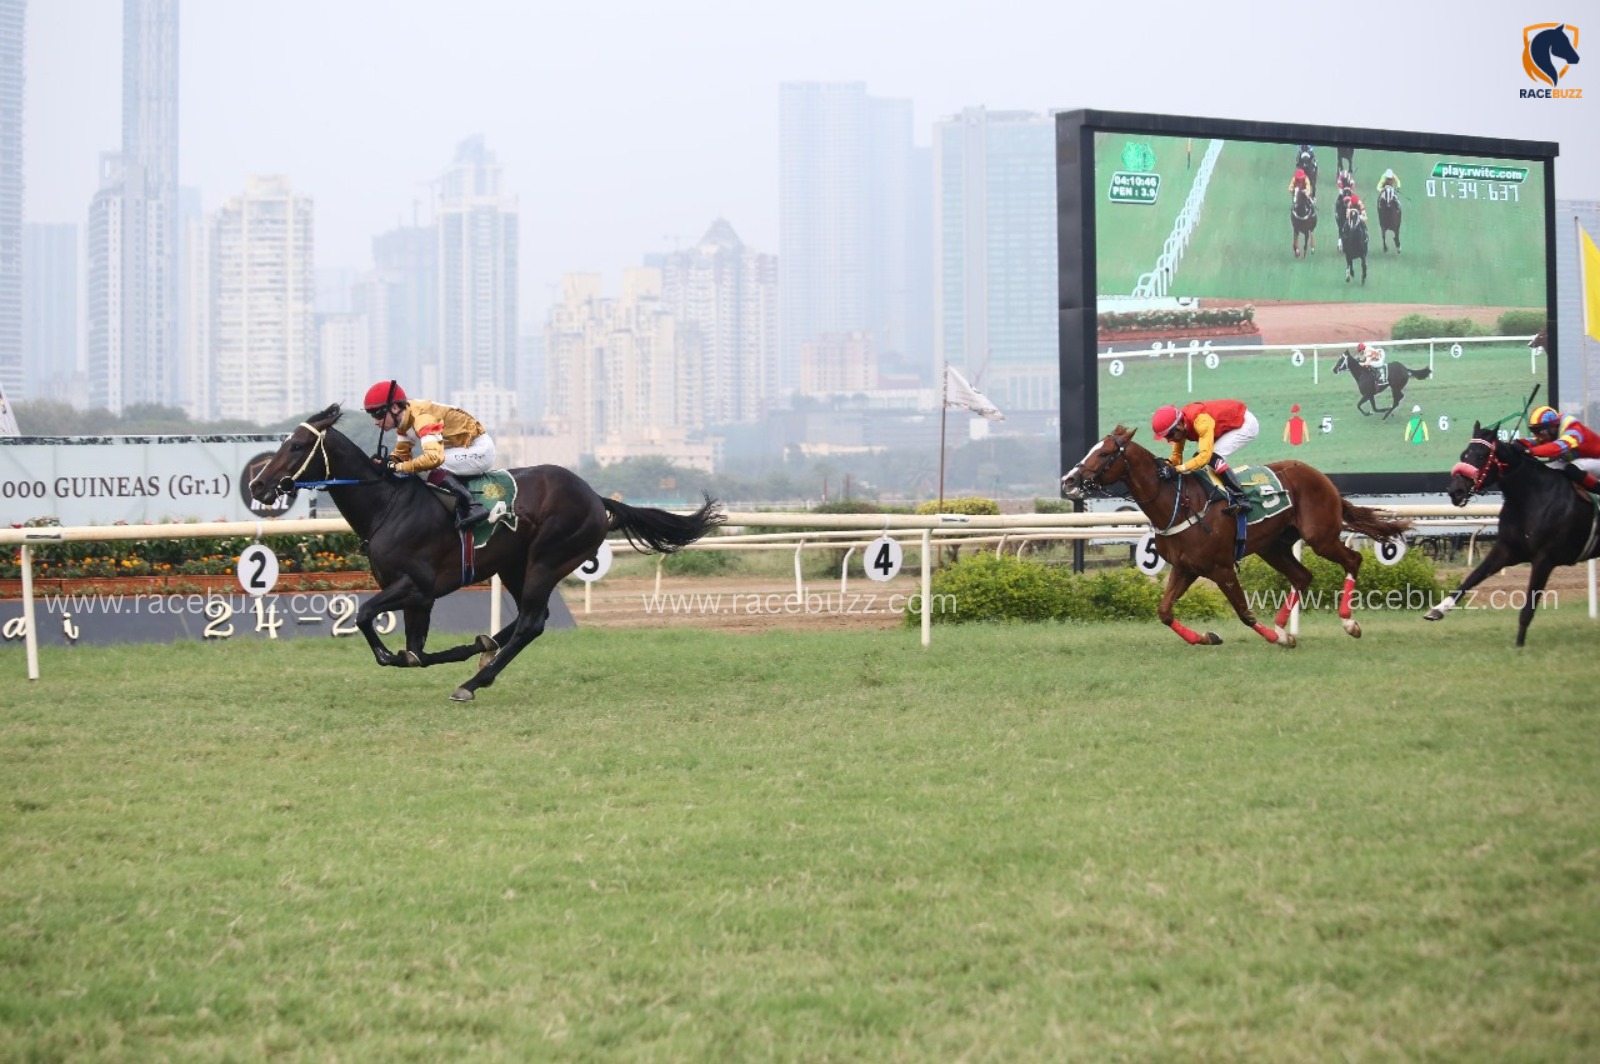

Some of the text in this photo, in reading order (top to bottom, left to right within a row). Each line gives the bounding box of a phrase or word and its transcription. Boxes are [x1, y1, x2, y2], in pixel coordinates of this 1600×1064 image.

[1441, 165, 1522, 180] play.rwitc.com
[1112, 186, 1133, 196] PEN
[1321, 417, 1332, 433] 5
[1438, 415, 1449, 431] 6
[54, 474, 161, 499] GUINEAS
[168, 473, 231, 500] (Gr.1)
[1260, 484, 1281, 509] 5
[487, 500, 512, 525] 4
[873, 543, 894, 576] 4
[1142, 537, 1160, 570] 5
[1381, 541, 1398, 561] 6
[249, 551, 267, 588] 2
